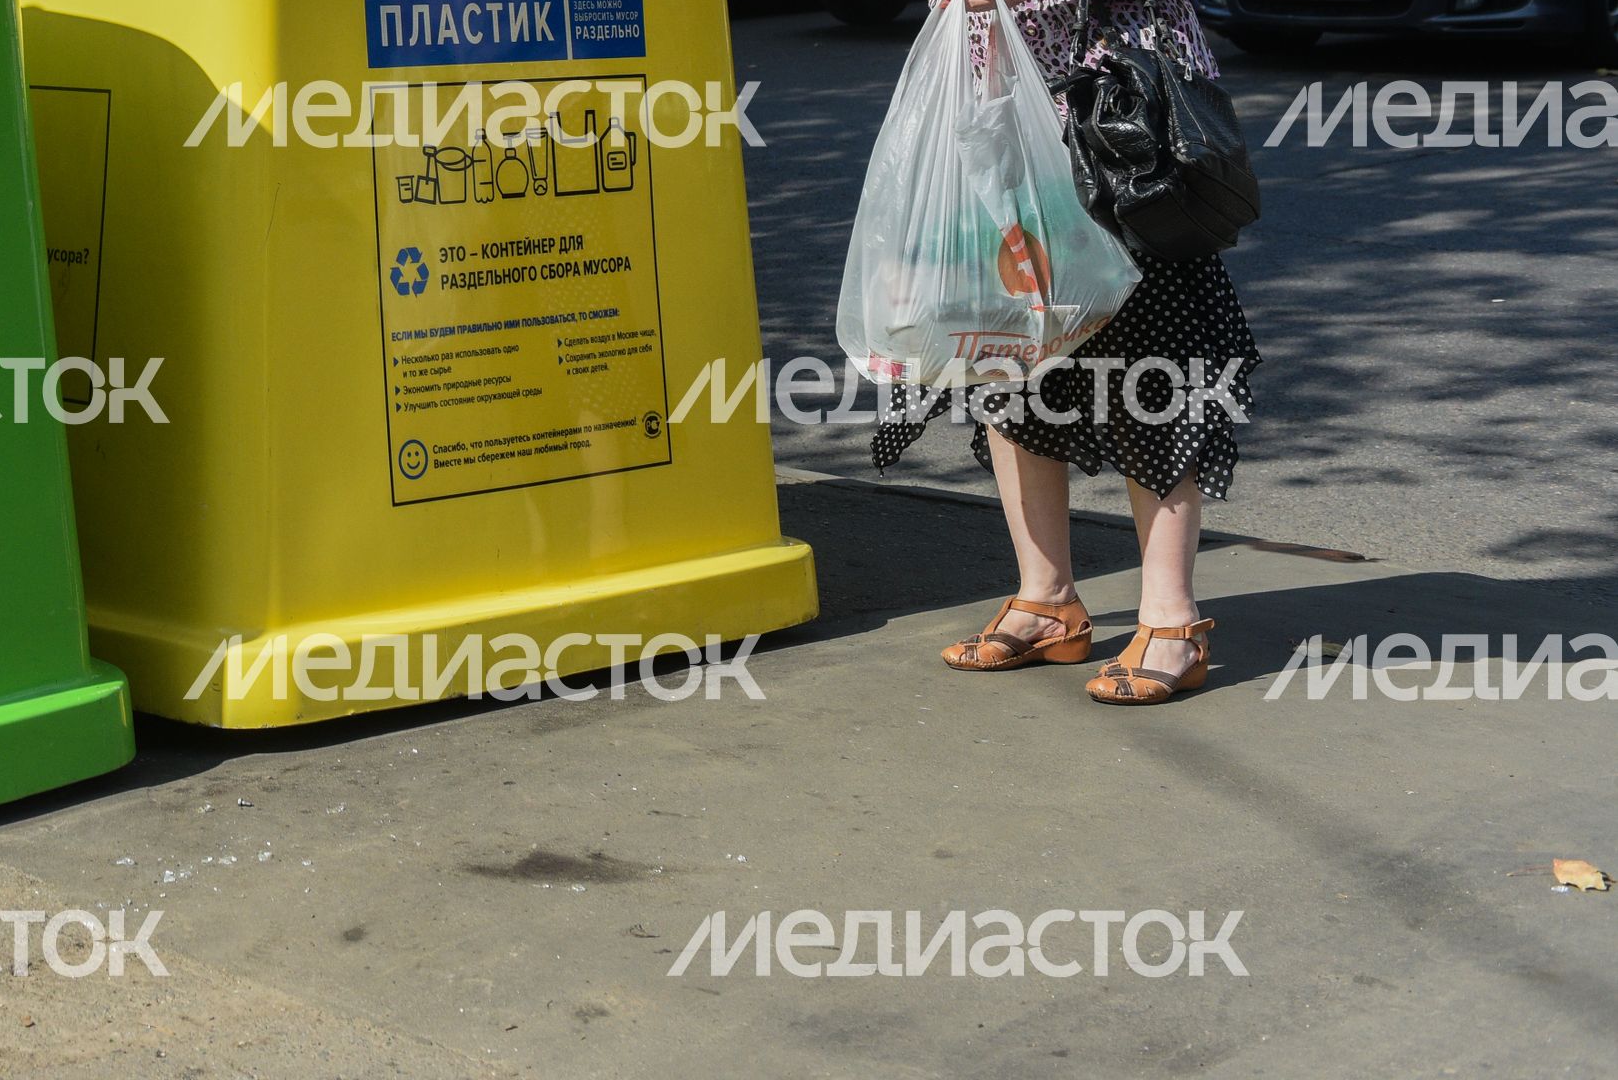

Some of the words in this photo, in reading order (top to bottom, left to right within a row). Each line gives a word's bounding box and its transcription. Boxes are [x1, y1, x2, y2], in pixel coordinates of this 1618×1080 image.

[573, 0, 595, 10] ЗДЕСЬ
[596, 0, 622, 9] МОЖНО
[380, 2, 555, 47] ПЛАСТИК
[574, 12, 615, 22] ВЫБРОСИТЬ
[615, 11, 639, 21] МУСОР
[575, 24, 640, 41] РАЗДЕЛЬНО
[47, 248, 90, 267] усора?
[439, 245, 466, 264] ЭТО
[481, 236, 556, 260] КОНТЕЙНЕР
[558, 234, 584, 255] ДЛЯ
[441, 265, 538, 291] РАЗДЕЛЬНОГО
[540, 261, 581, 281] СБОРА
[583, 256, 632, 276] МУСОРА
[391, 330, 413, 342] ЕСЛИ
[414, 329, 428, 339] МЫ
[429, 326, 456, 338] БУДЕМ
[456, 320, 503, 334] ПРАВИЛЬНО
[503, 319, 521, 330] ИМИ
[521, 312, 578, 327] ПОЛЬЗОВАТЬСЯ,
[578, 311, 588, 321] ТО
[588, 307, 620, 320] СМОЖЕМ:
[564, 337, 590, 348] Сделать
[590, 334, 611, 344] воздух
[611, 333, 616, 341] в
[616, 331, 639, 340] Москве
[639, 328, 657, 337] чище,
[401, 353, 440, 365] Несколько
[440, 352, 454, 363] раз
[455, 346, 502, 359] использовать
[502, 344, 520, 354] одно
[565, 352, 597, 363] Сохранить
[597, 348, 627, 359] экологию
[627, 346, 638, 356] для
[638, 343, 653, 353] себя
[408, 369, 417, 378] то
[418, 368, 429, 377] же
[429, 366, 452, 377] сырье
[566, 368, 571, 376] и
[571, 366, 590, 376] своих
[590, 362, 609, 374] детей.
[403, 383, 442, 396] Экономить
[442, 378, 482, 392] природные
[483, 375, 512, 387] ресурсы
[403, 400, 439, 413] Улучшить
[439, 396, 476, 408] состояние
[476, 388, 521, 404] окружающей
[521, 387, 543, 399] среды
[432, 441, 469, 455] Спасибо,
[469, 440, 483, 449] что
[484, 434, 531, 448] пользуетесь
[532, 427, 582, 441] контейнерами
[583, 425, 593, 433] по
[593, 416, 637, 431] назначению!
[433, 458, 462, 469] Вместе
[463, 456, 476, 465] мы
[477, 450, 516, 463] сбережем
[516, 448, 533, 457] наш
[533, 441, 569, 455] любимый
[569, 439, 591, 451] город.
